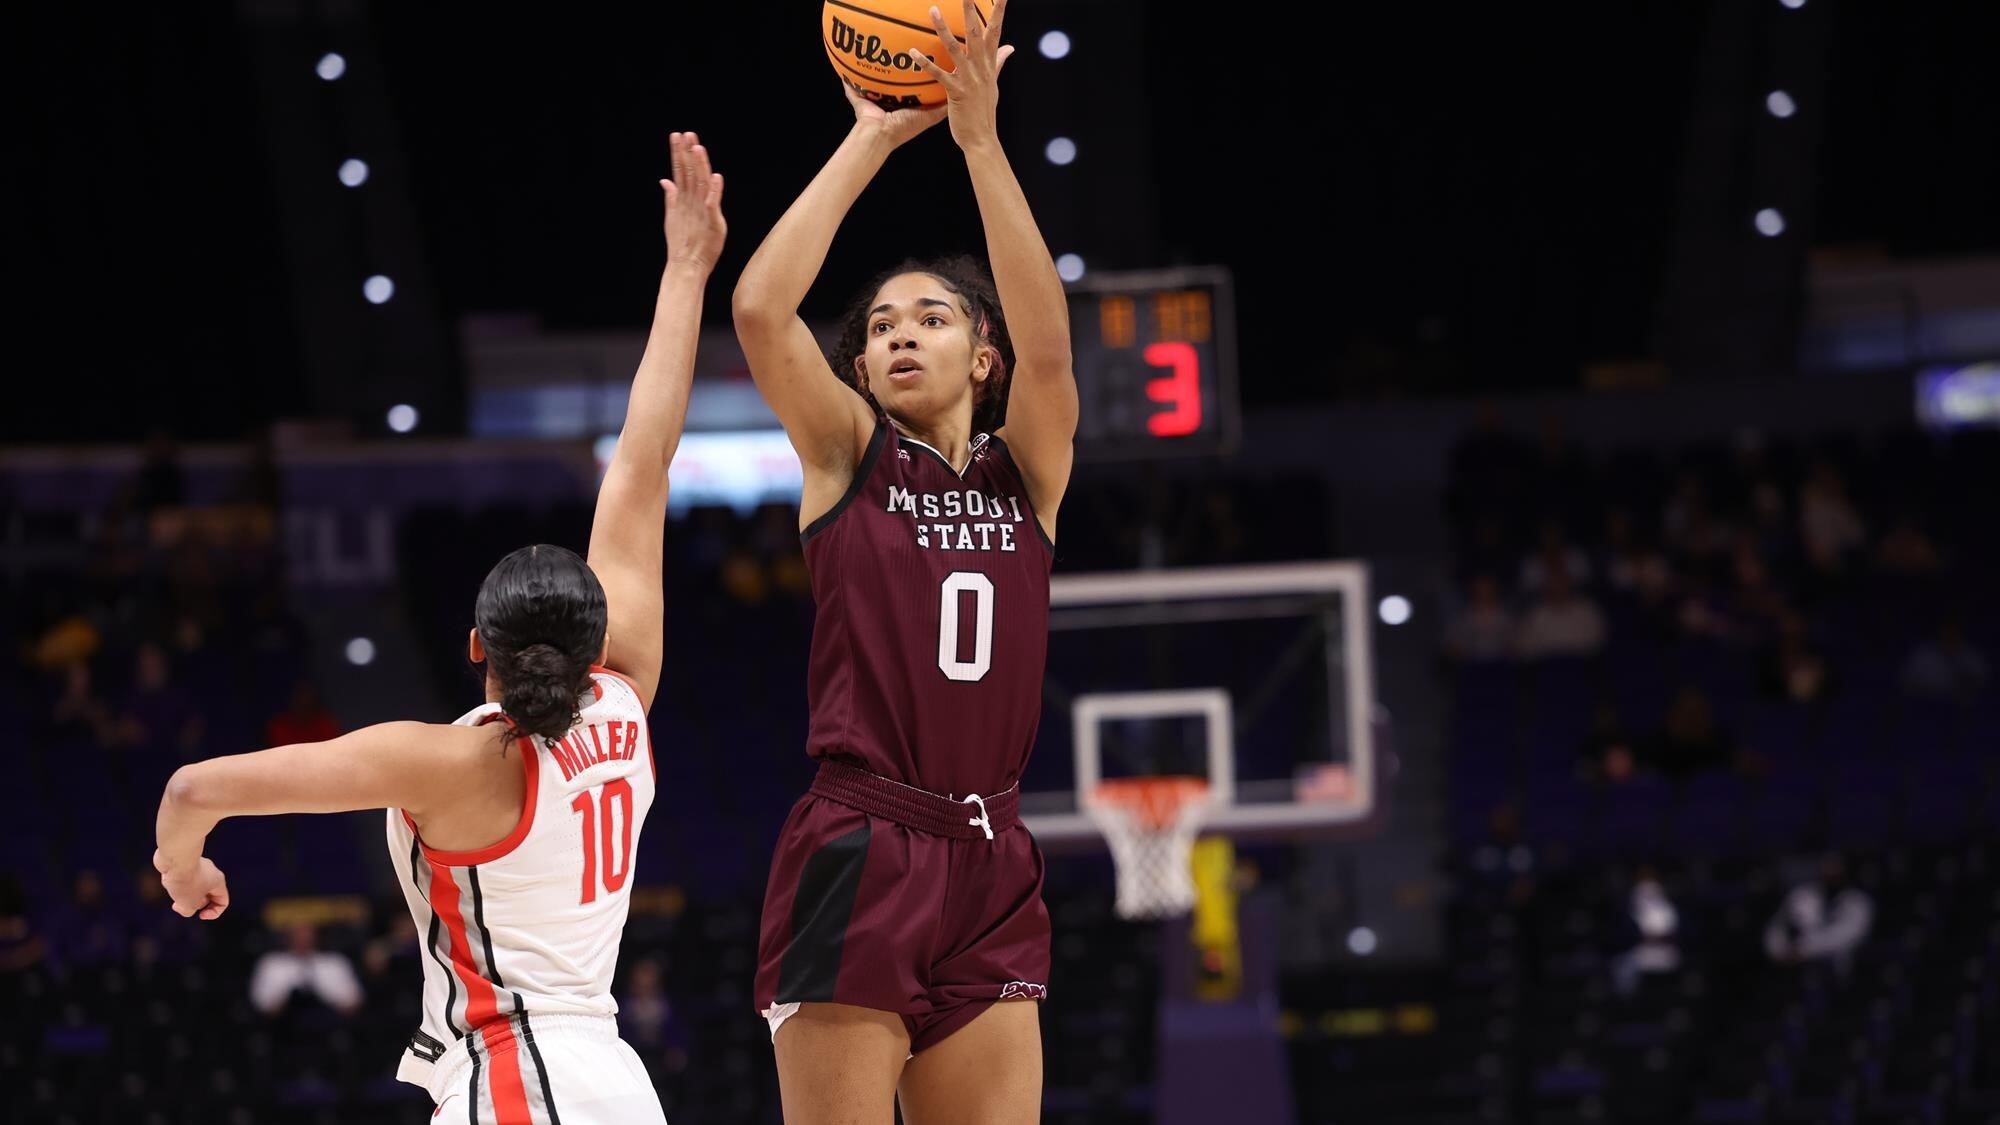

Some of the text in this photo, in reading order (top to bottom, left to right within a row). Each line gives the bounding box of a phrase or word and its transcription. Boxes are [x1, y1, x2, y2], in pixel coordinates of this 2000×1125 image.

[1143, 342, 1202, 437] 3
[887, 485, 1024, 522] MISSOUI
[917, 522, 1016, 551] STATE
[938, 571, 995, 682] 0
[550, 720, 639, 783] MILLER
[571, 776, 634, 905] 10
